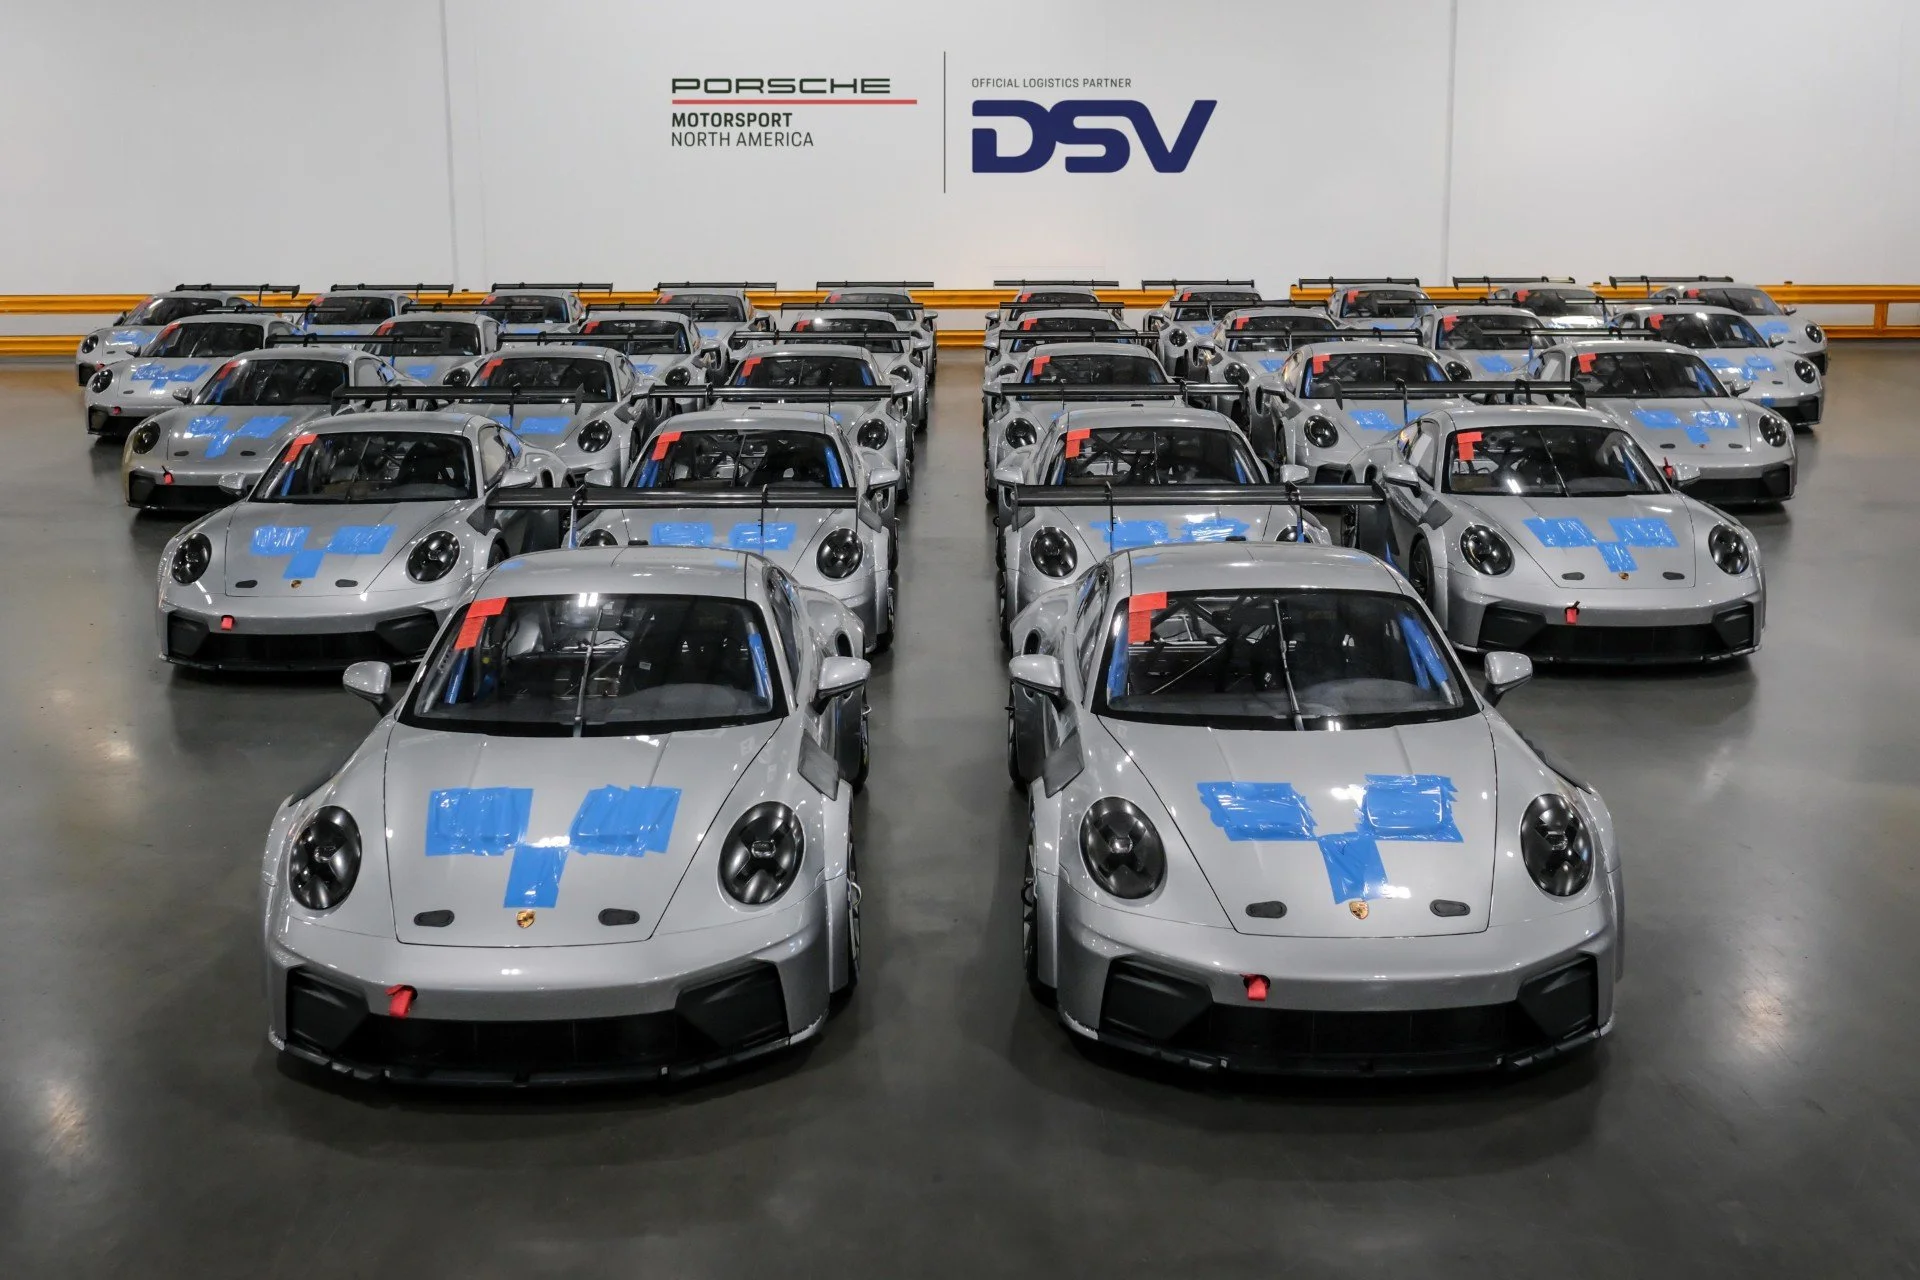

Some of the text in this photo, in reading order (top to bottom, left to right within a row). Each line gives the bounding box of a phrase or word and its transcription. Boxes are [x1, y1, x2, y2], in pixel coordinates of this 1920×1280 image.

[671, 78, 891, 95] PORSCHE
[971, 77, 1132, 89] OFFICIAL LOGISTICS PARTNER
[671, 112, 793, 128] MOTORSPORT
[671, 132, 814, 148] NORTH AMERICA
[971, 99, 1218, 174] DSV
